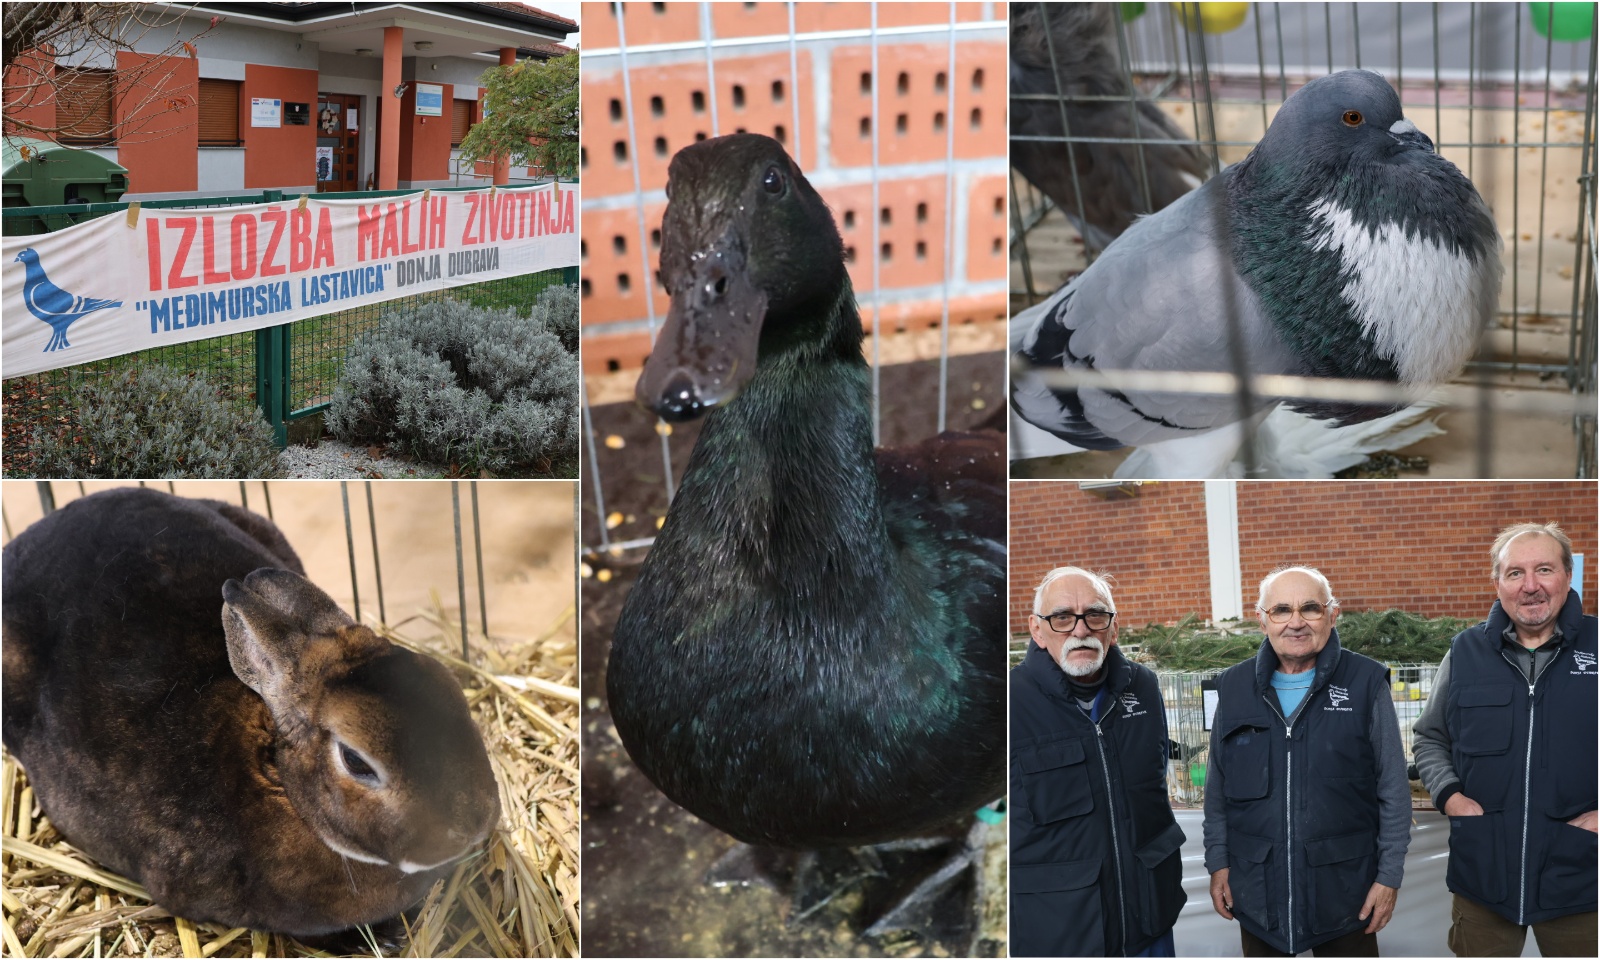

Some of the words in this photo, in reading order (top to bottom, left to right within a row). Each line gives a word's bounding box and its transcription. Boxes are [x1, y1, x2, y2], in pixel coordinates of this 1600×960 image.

[146, 206, 336, 292] IZLOŽBA
[357, 195, 447, 262] MALIH
[462, 190, 575, 246] ŽIVOTINJA
[135, 280, 292, 334] "MEĐIMURSKA
[301, 264, 391, 307] LASTAVICA"
[396, 254, 441, 287] DONJA
[448, 246, 499, 277] DUBRAVA
